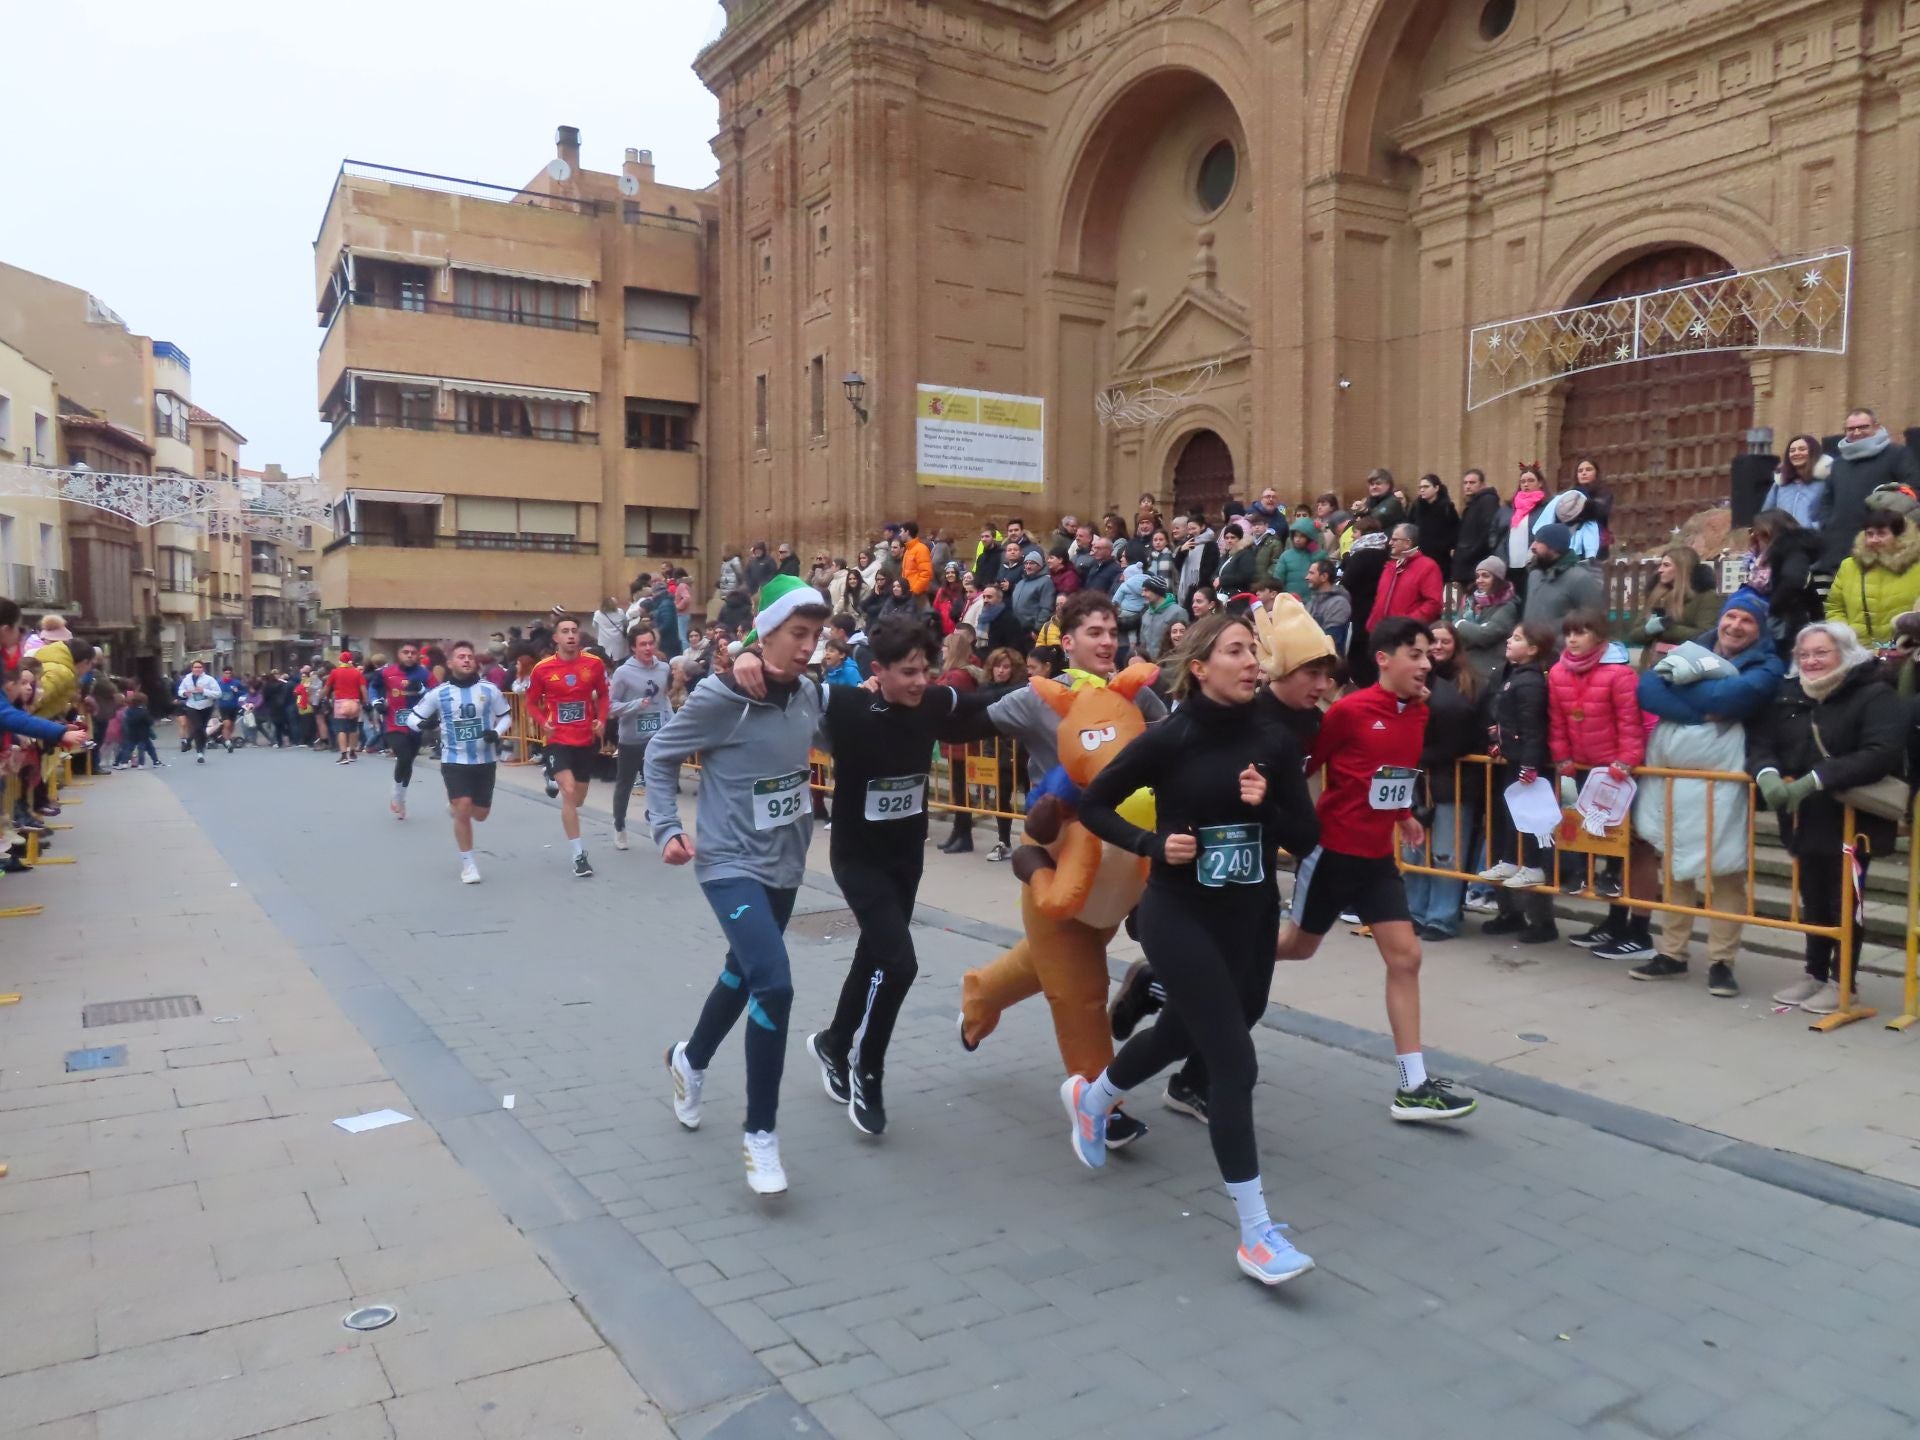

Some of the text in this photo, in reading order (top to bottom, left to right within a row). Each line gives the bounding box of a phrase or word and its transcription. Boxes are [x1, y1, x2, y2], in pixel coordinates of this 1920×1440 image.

[459, 703, 477, 718] 10
[562, 709, 581, 721] 252
[640, 719, 658, 731] 306
[460, 727, 478, 740] 251
[1379, 785, 1406, 802] 918
[767, 792, 801, 819] 925
[878, 794, 913, 813] 928
[1210, 849, 1252, 879] 249
